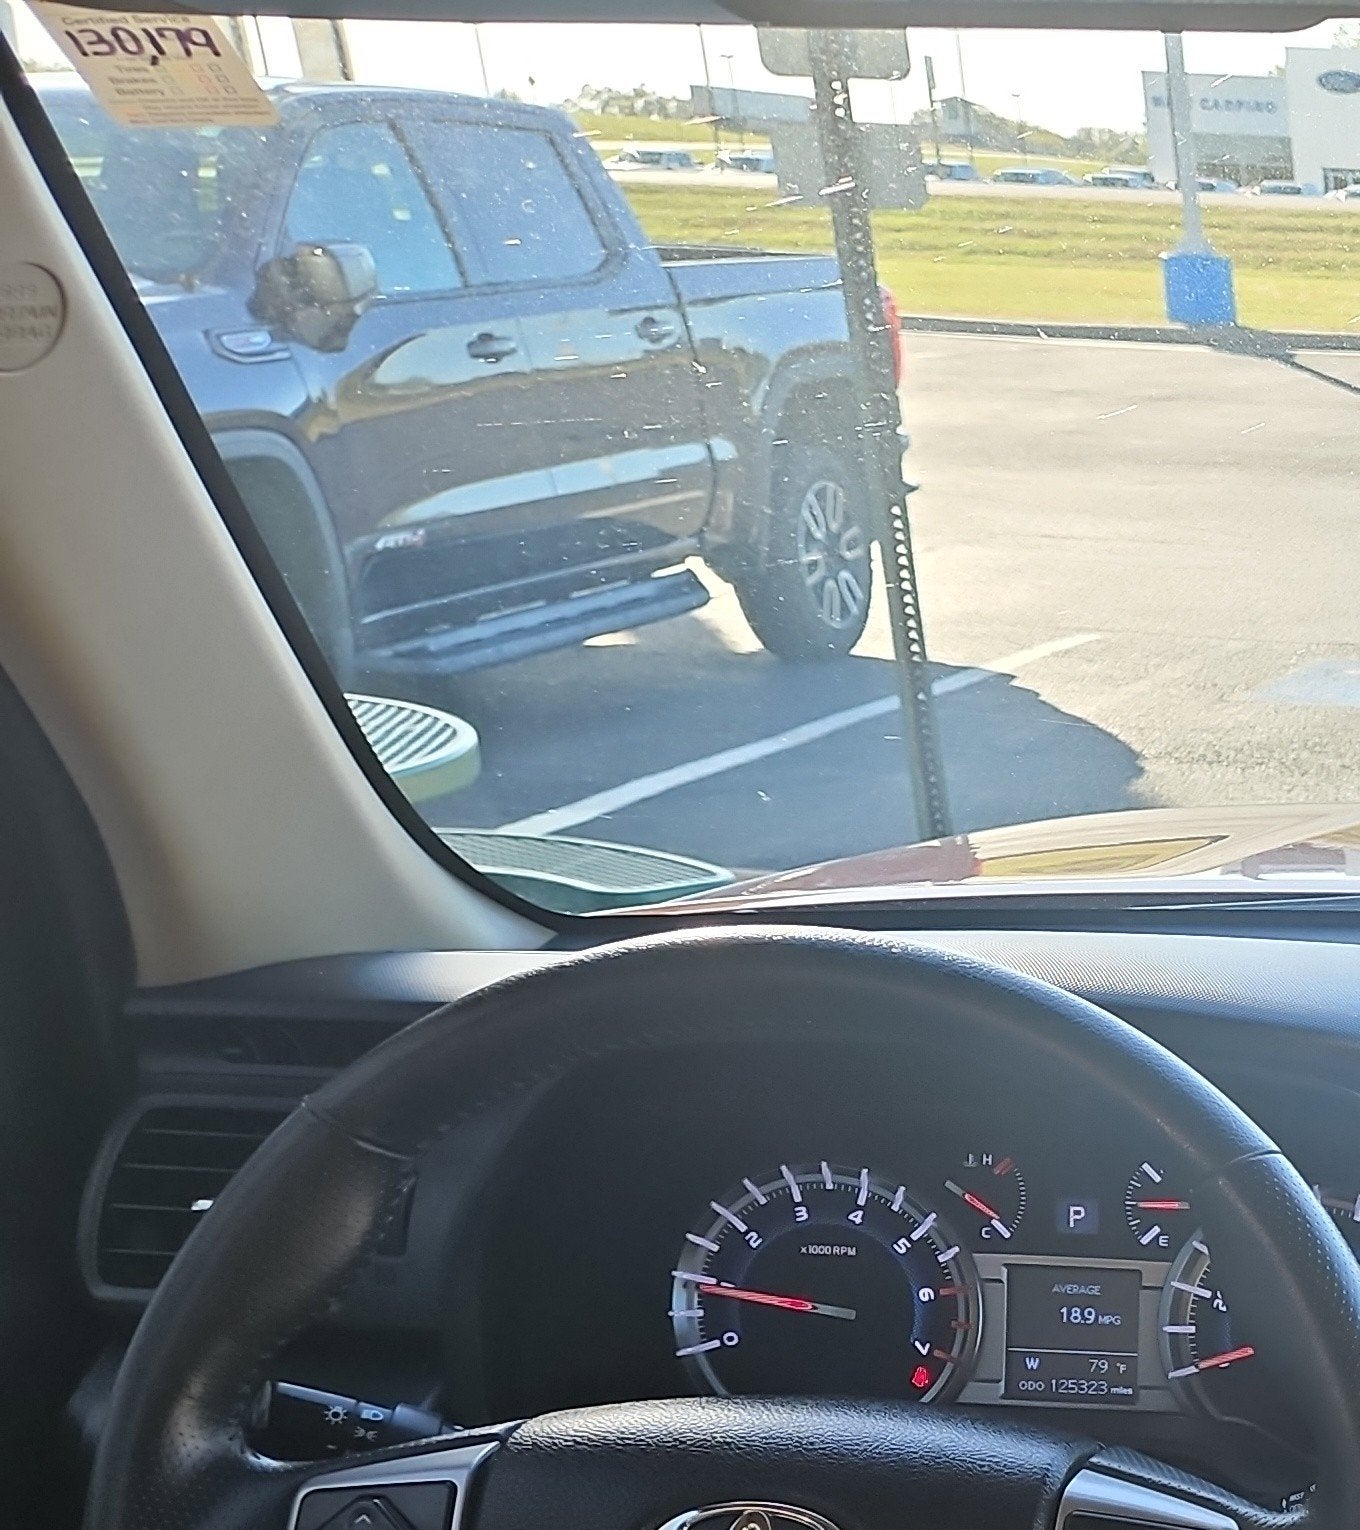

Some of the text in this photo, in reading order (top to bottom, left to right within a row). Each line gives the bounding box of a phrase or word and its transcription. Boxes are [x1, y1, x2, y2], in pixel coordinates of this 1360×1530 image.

[62, 14, 191, 26] Certified Service
[64, 25, 221, 66] 130,179
[982, 1153, 993, 1166] H
[794, 1206, 810, 1222] 3
[847, 1209, 864, 1225] 4
[1069, 1206, 1085, 1227] P
[743, 1231, 763, 1250] 2
[980, 1227, 991, 1239] C
[1158, 1235, 1170, 1247] E
[892, 1237, 912, 1254] 5
[917, 1287, 936, 1303] 6
[1052, 1284, 1101, 1295] AVERAGE
[1059, 1307, 1122, 1326] 18.9 MPG
[722, 1331, 739, 1347] 0
[914, 1339, 932, 1356] 7
[1024, 1357, 1041, 1371] W
[1088, 1359, 1109, 1373] 79
[1018, 1378, 1133, 1396] ODO 125323 miles
